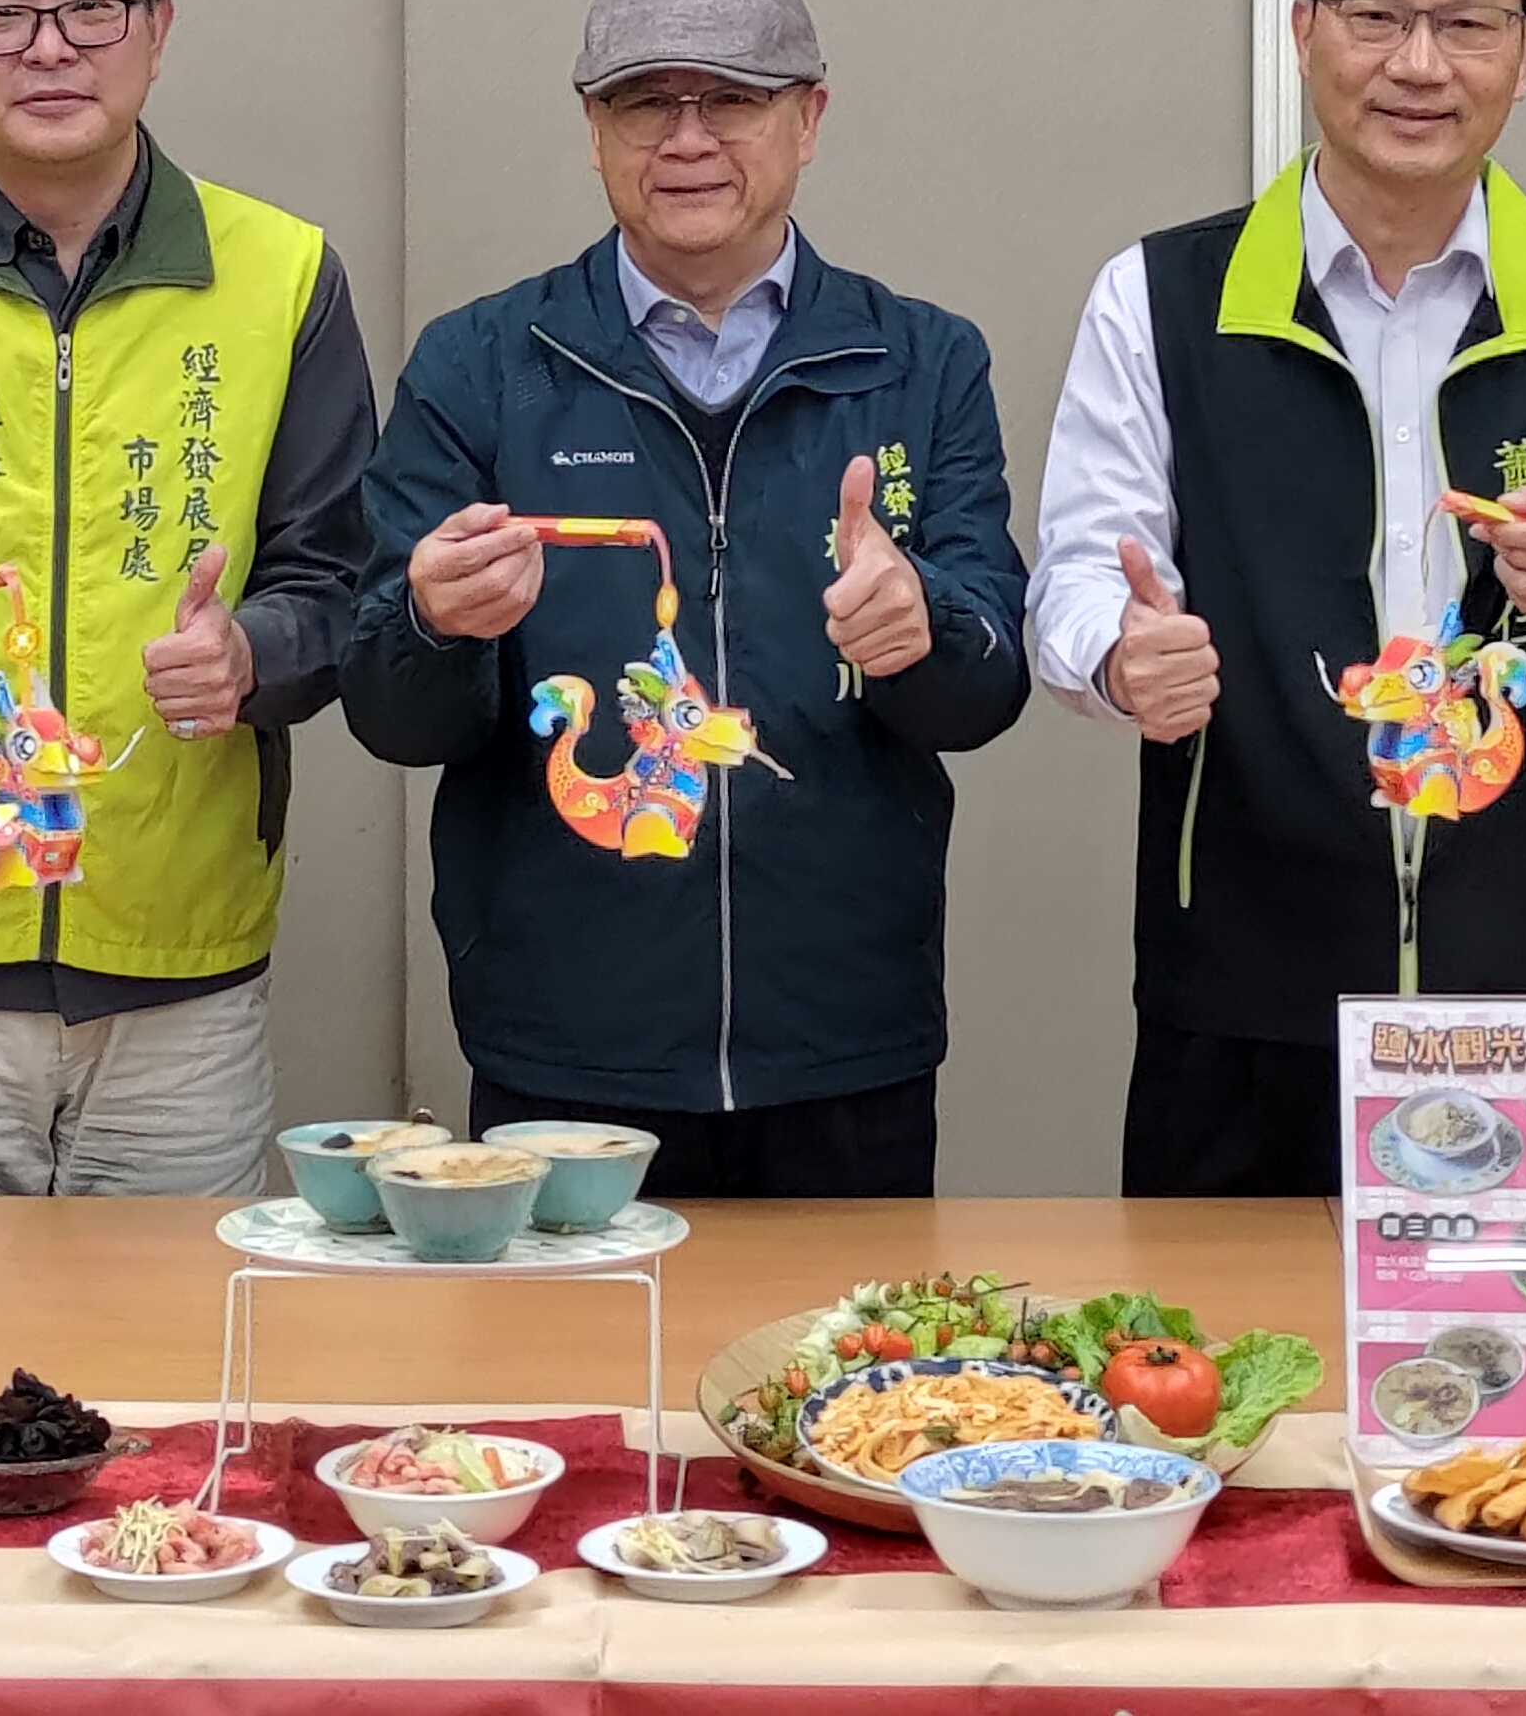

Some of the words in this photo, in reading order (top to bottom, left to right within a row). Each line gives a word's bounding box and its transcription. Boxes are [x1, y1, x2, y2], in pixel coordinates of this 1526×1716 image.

[119, 434, 162, 582] 市場處
[176, 343, 223, 575] 經濟發展局
